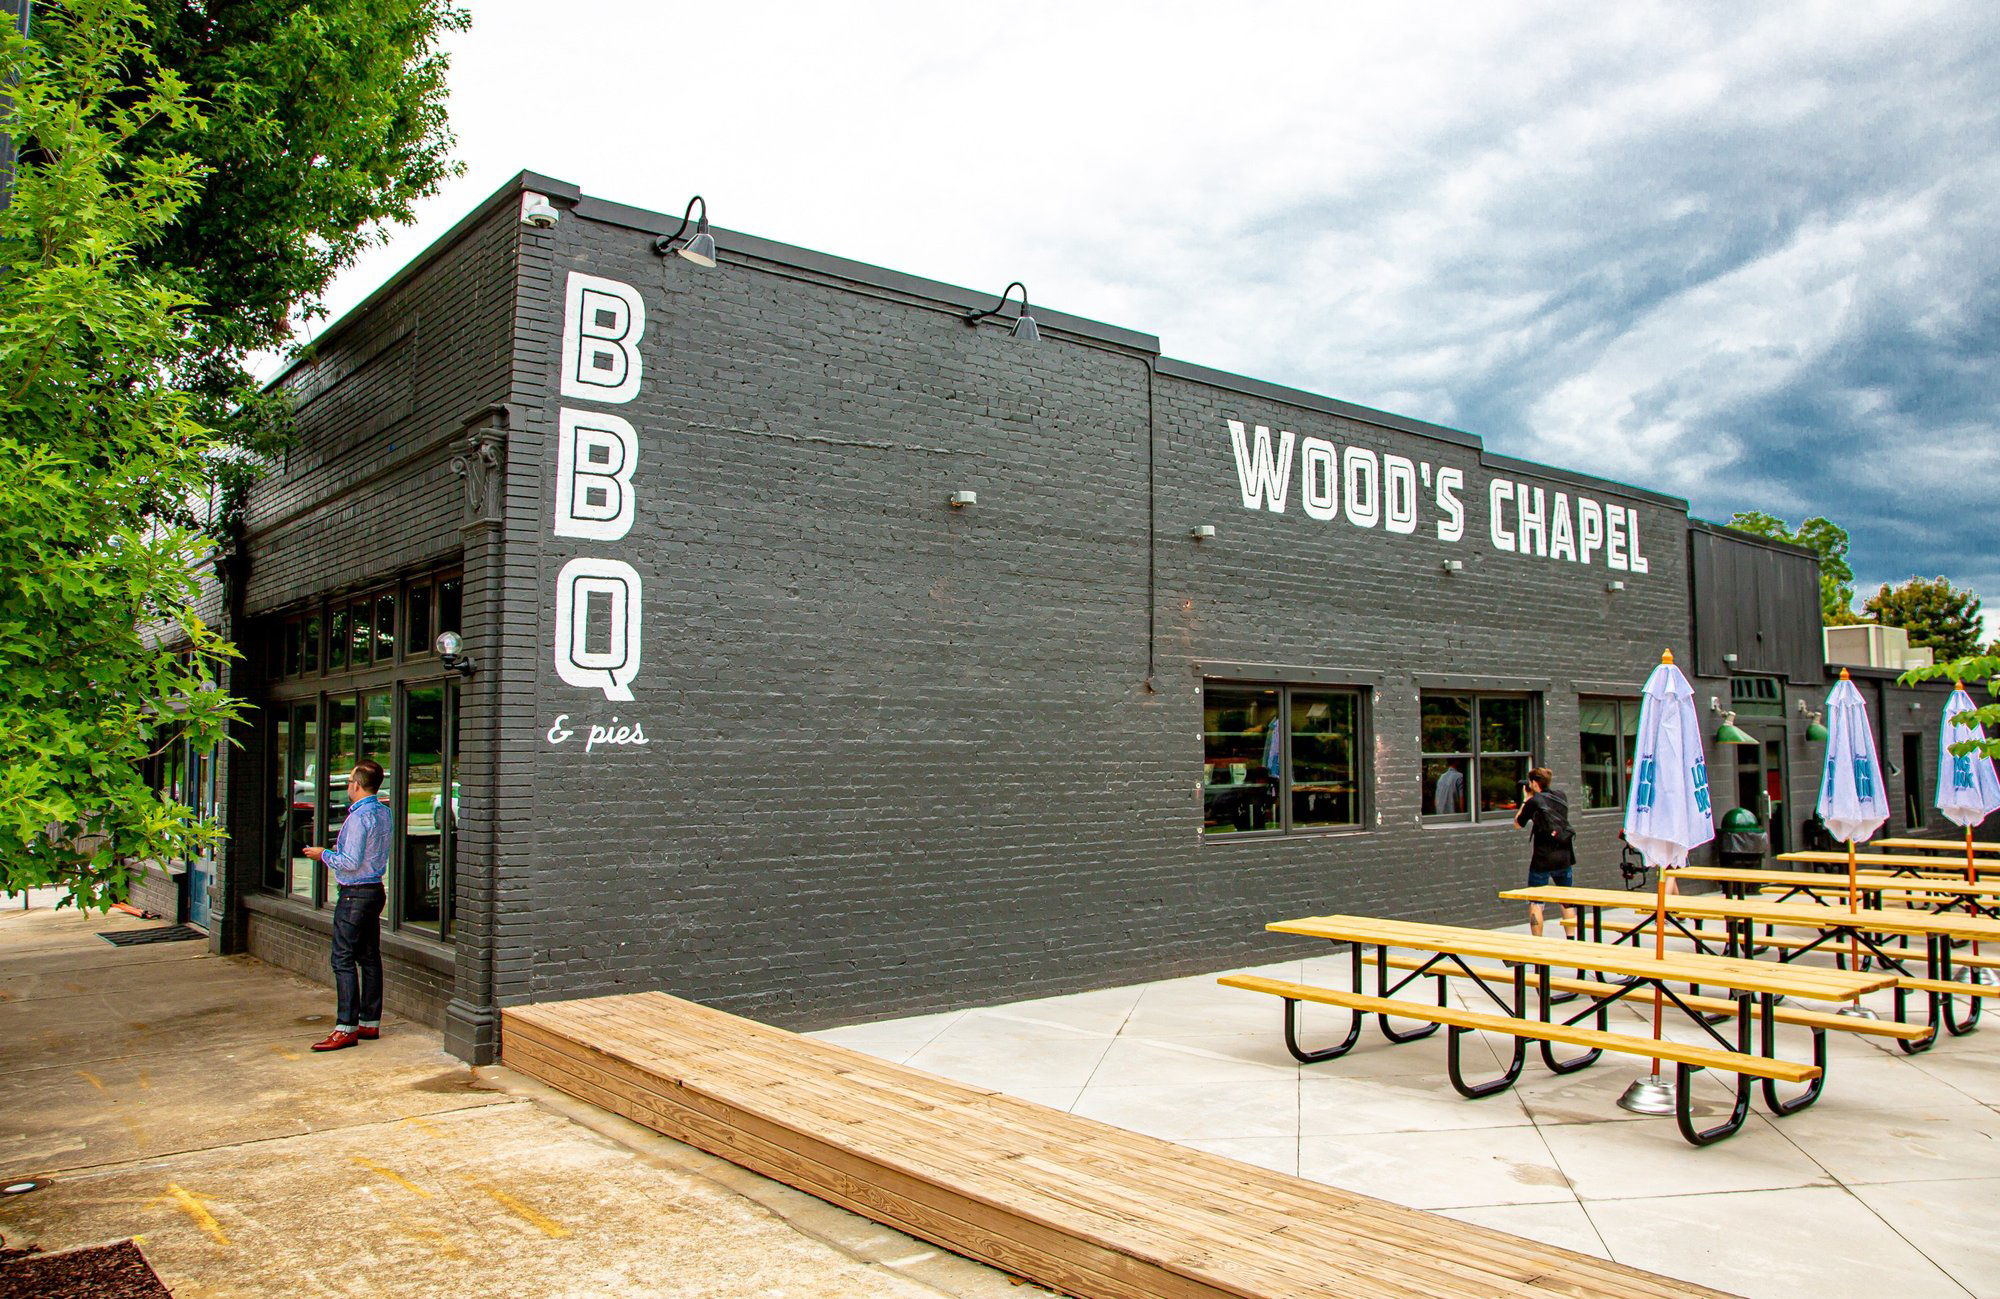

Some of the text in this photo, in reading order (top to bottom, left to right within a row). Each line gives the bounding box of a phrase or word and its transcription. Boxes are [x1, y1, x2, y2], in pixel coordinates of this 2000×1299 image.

[554, 271, 646, 701] BBQ
[1227, 420, 1649, 574] WOOD'S CHAPEL
[547, 714, 650, 753] & pies
